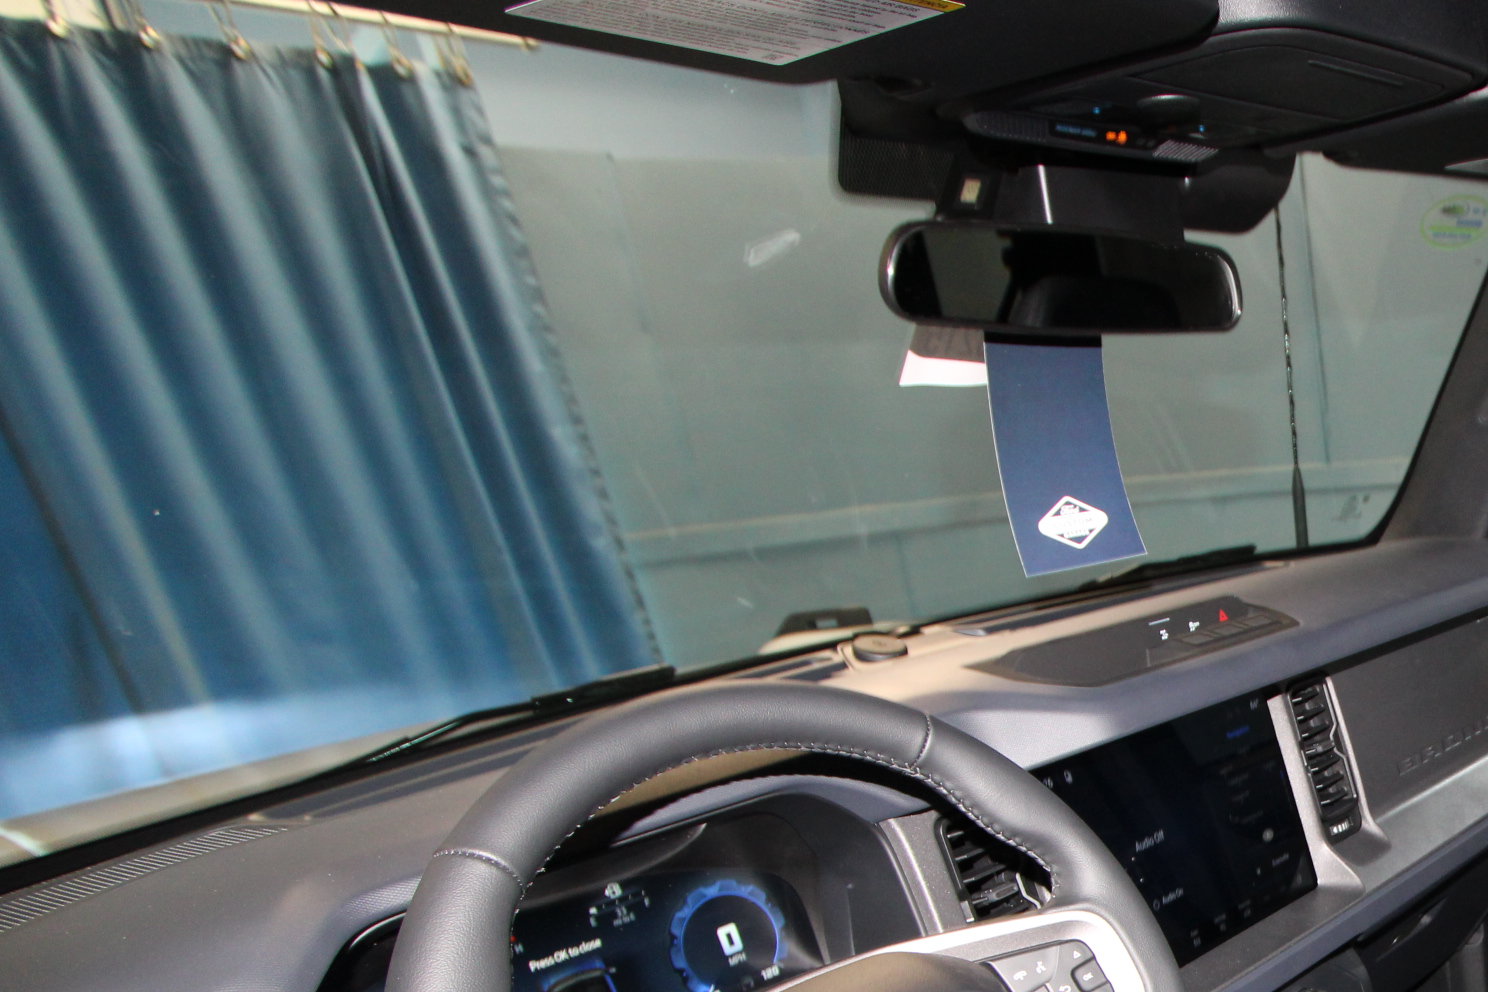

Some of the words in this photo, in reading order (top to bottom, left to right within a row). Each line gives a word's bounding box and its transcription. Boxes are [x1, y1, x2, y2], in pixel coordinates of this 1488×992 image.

[528, 955, 555, 973] Press
[554, 948, 569, 963] OK
[568, 946, 580, 958] to
[579, 937, 602, 954] close
[717, 922, 744, 957] 0
[728, 951, 747, 968] MPH
